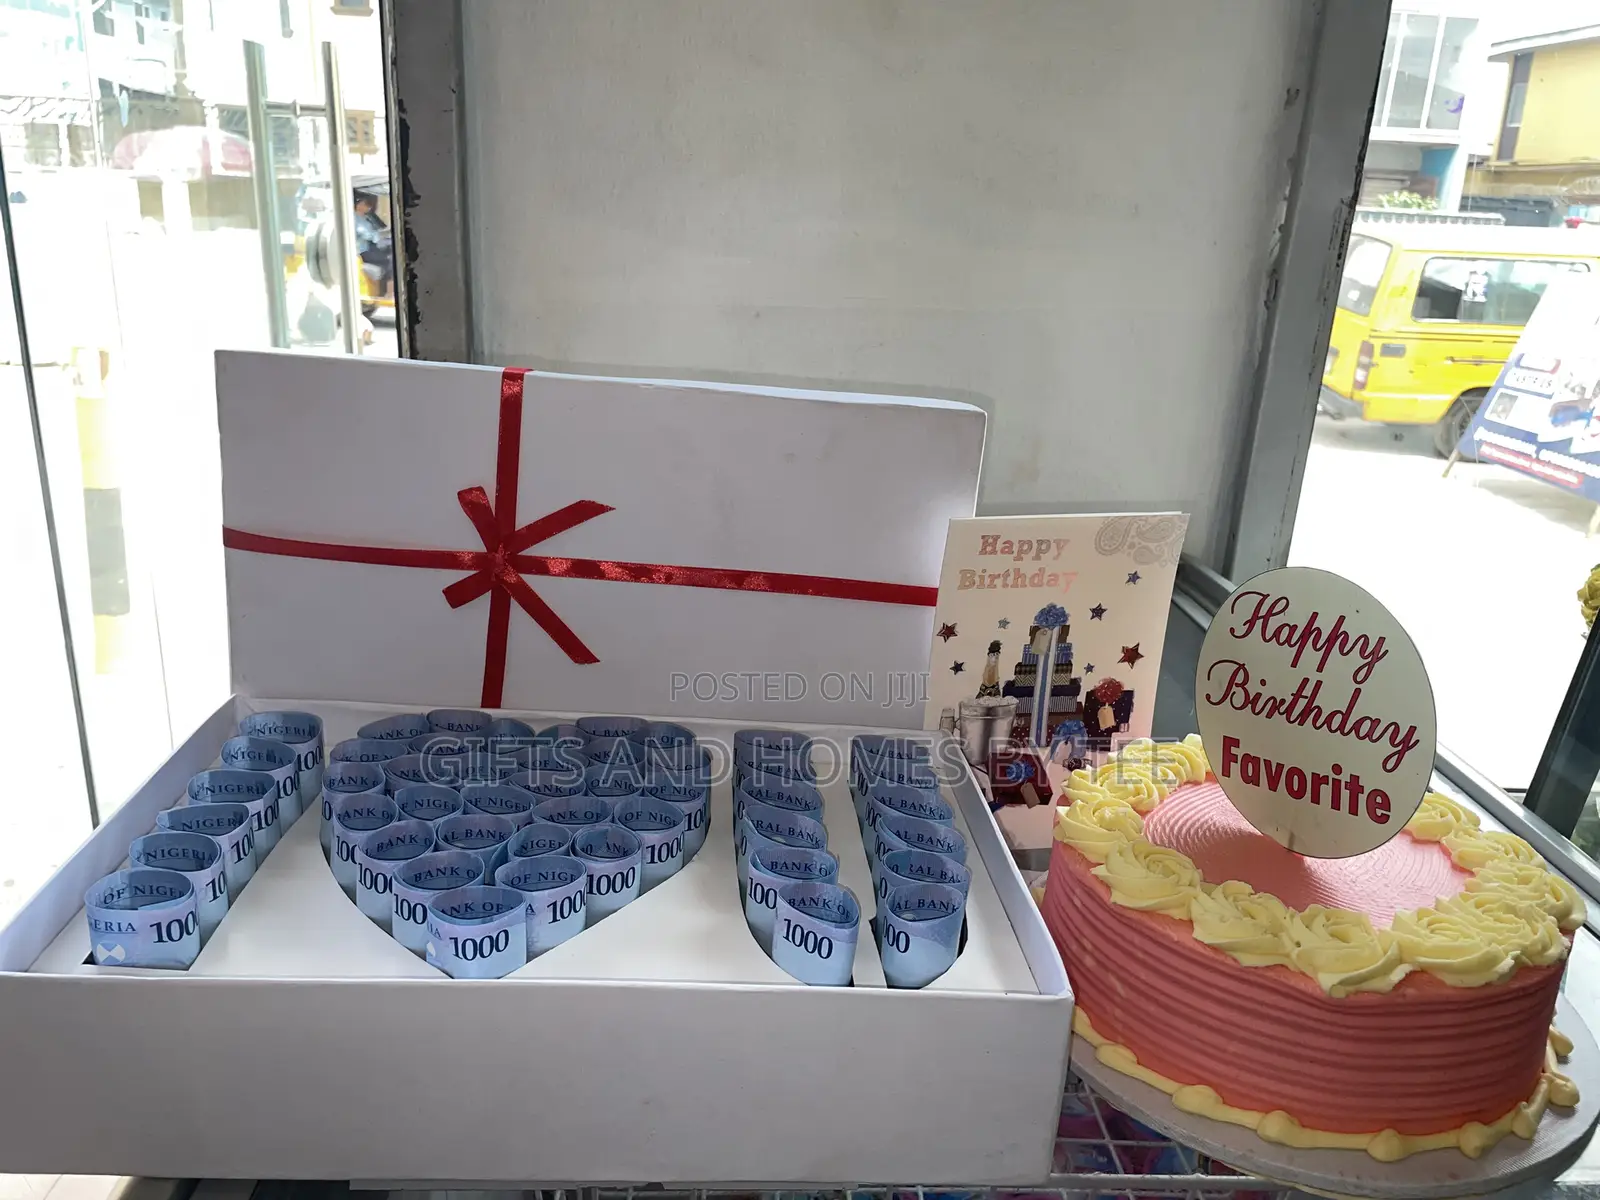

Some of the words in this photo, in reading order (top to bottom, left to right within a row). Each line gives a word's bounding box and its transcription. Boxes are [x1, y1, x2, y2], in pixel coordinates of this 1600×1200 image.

[977, 534, 1071, 561] Happy
[957, 568, 1079, 594] Birthday
[1229, 590, 1389, 685] Happy
[1205, 659, 1420, 773] Birthday
[1221, 735, 1391, 825] Favorite
[901, 799, 936, 817] BANK
[917, 833, 954, 852] BANK
[414, 866, 460, 883] BANK
[771, 860, 814, 873] BANK
[587, 866, 636, 896] 1000
[788, 896, 832, 910] BANK
[449, 928, 510, 962] 1000
[782, 918, 833, 960] 1000
